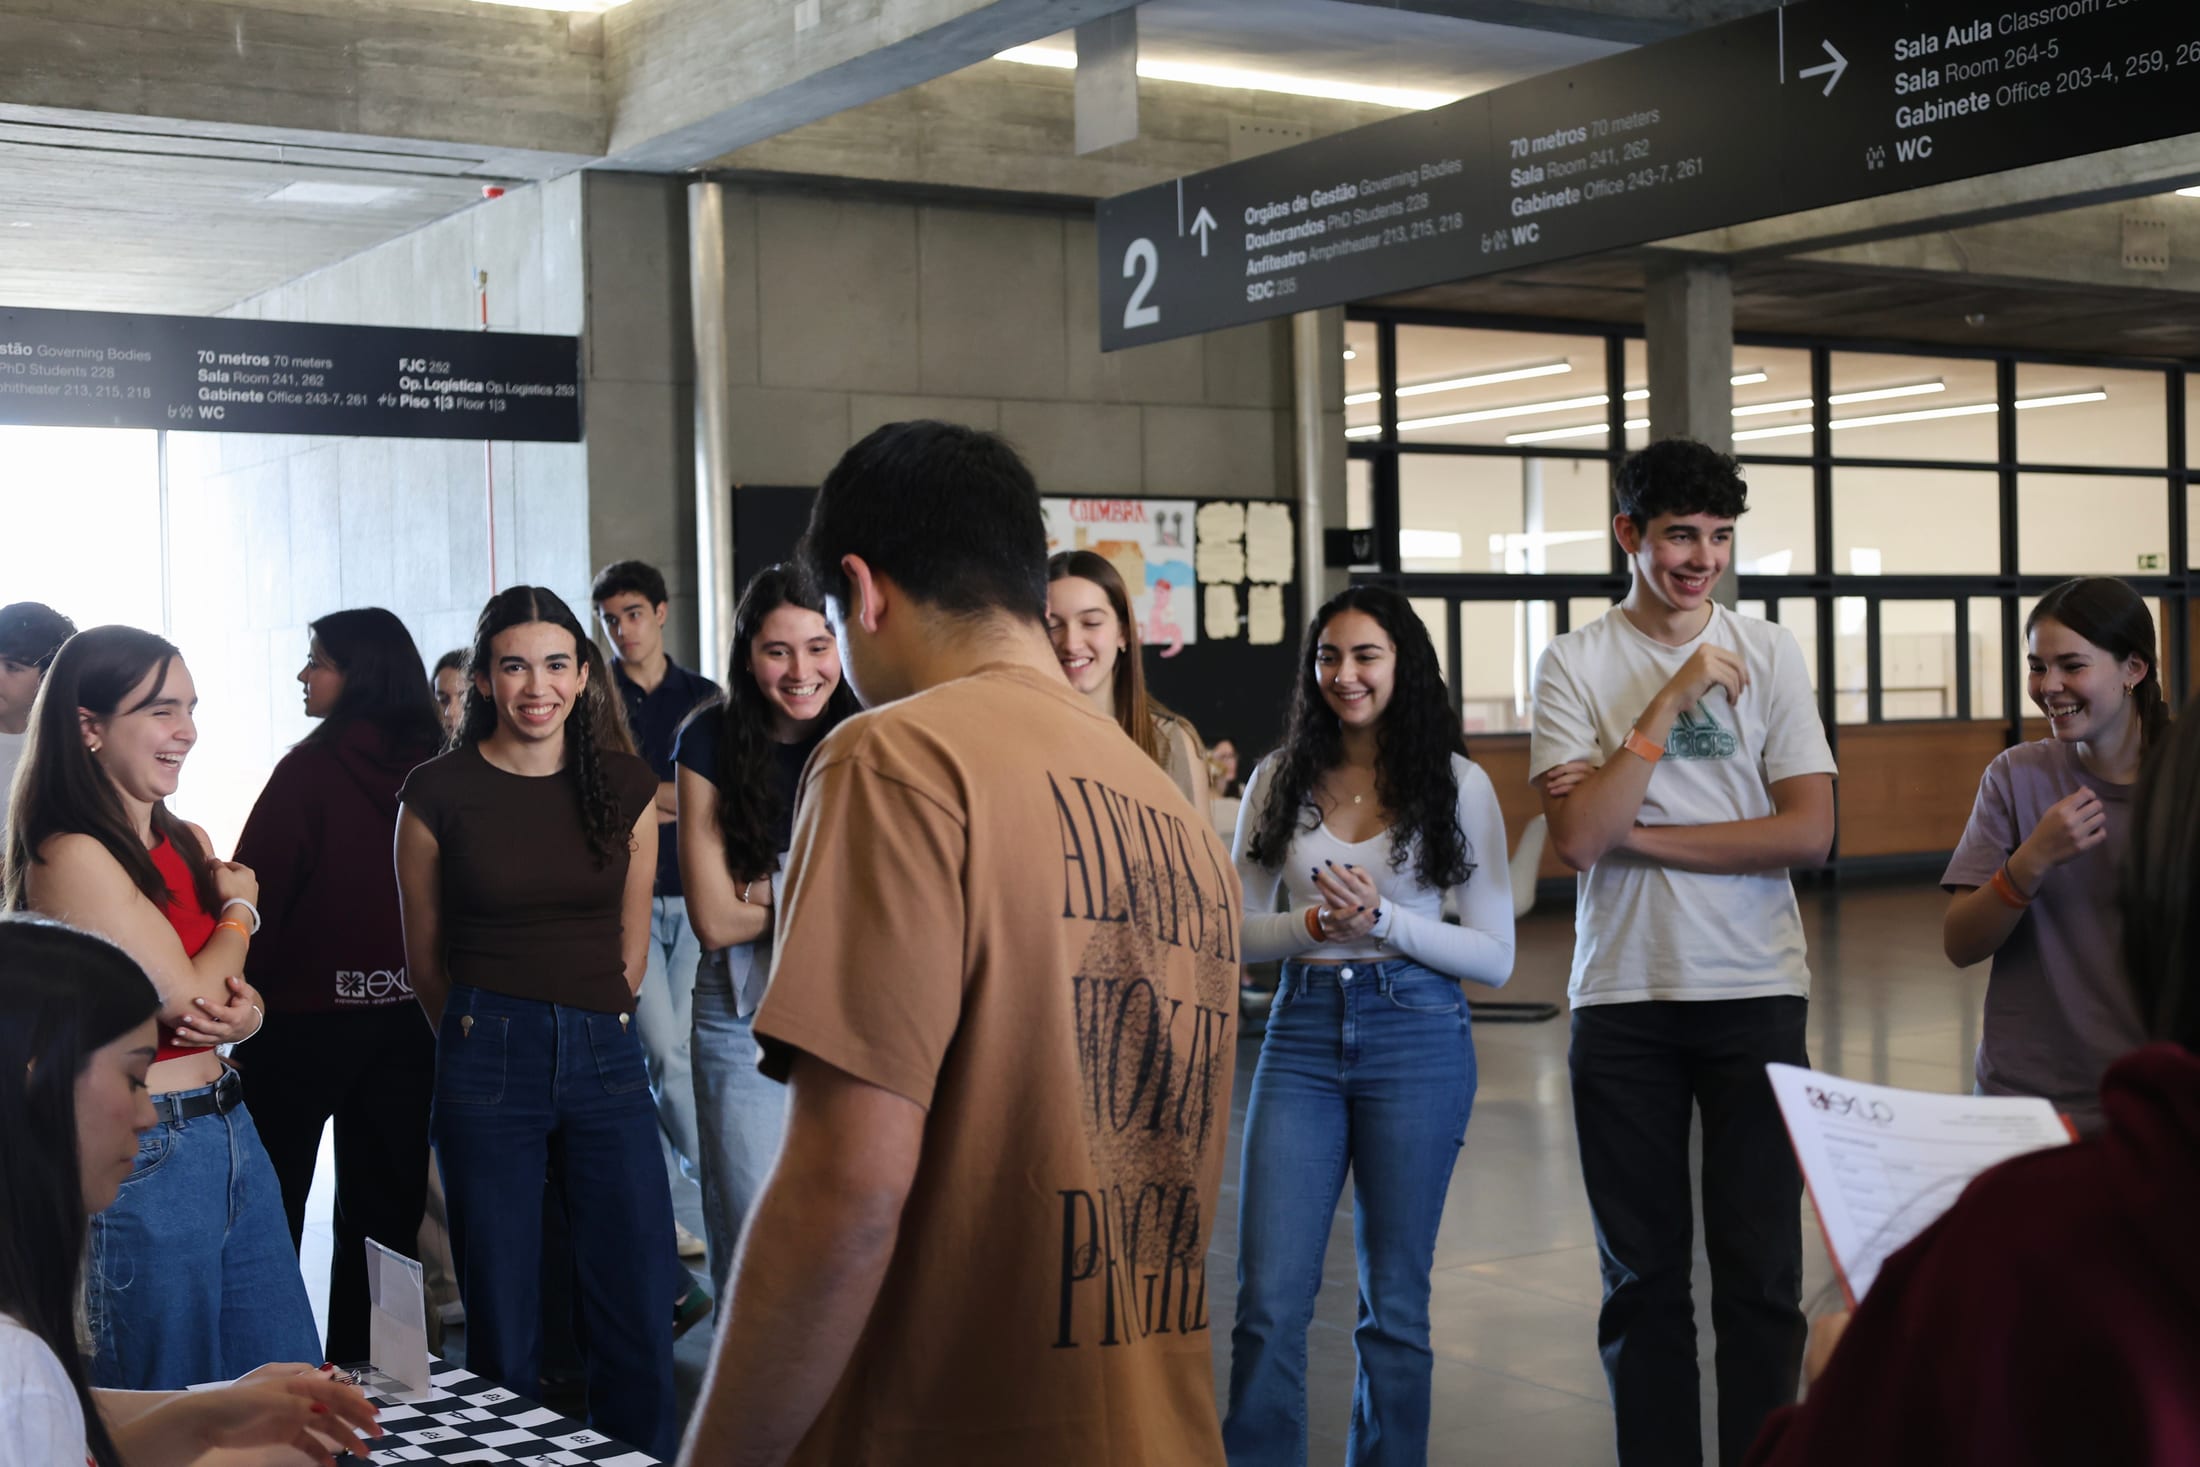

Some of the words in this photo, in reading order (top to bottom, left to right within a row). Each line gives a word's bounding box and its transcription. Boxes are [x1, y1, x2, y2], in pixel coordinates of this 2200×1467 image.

[1894, 33, 1939, 61] Sala
[1944, 19, 1992, 49] Aula
[1998, 0, 2100, 35] Classroom
[1895, 67, 1940, 95] Sala
[1945, 56, 1998, 83] Room
[2004, 38, 2059, 70] 264-5
[1895, 90, 1990, 129] Gabinete
[1995, 78, 2051, 107] Office
[2056, 61, 2119, 93] 203-4,
[2126, 50, 2169, 77] 259,
[2176, 41, 2200, 66] 26
[1509, 137, 1528, 158] 70
[1531, 124, 1587, 152] metros
[1591, 119, 1608, 139] 70
[1611, 108, 1660, 134] meters
[1895, 136, 1932, 162] WC
[1510, 163, 1544, 189] Sala
[1547, 157, 1587, 180] Room
[1623, 139, 1650, 161] 262
[1292, 195, 1309, 212] de
[1310, 182, 1357, 208] Gestão
[1359, 169, 1418, 196] Governing
[1420, 158, 1463, 181] Bodies
[1511, 185, 1580, 217] Gabinete
[1583, 177, 1625, 201] Office
[1677, 156, 1703, 178] 261
[1246, 219, 1326, 251] Doutorandos
[1327, 211, 1351, 231] PhD
[1353, 199, 1405, 225] Students
[1512, 222, 1540, 247] WC
[1246, 249, 1307, 277] Anfiteatro
[1308, 232, 1381, 262] Amphitheater
[1123, 238, 1160, 329] 2
[1246, 280, 1275, 302] SDC
[0, 341, 33, 356] stão
[37, 344, 104, 362] Governing
[107, 347, 152, 362] Bodies
[197, 350, 215, 364] 70
[219, 352, 270, 367] metros
[273, 355, 289, 367] 70
[291, 357, 333, 369] meters
[29, 363, 87, 377] Students
[91, 366, 115, 379] 228
[198, 369, 230, 383] Sala
[233, 372, 269, 385] Room
[301, 374, 325, 387] 262
[399, 358, 427, 373] FJC
[127, 387, 151, 399] 218
[198, 387, 264, 403] Gabinete
[267, 391, 302, 404] Office
[346, 394, 368, 406] 261
[400, 394, 430, 409] Piso
[457, 397, 486, 410] Floor
[198, 406, 225, 419] WC
